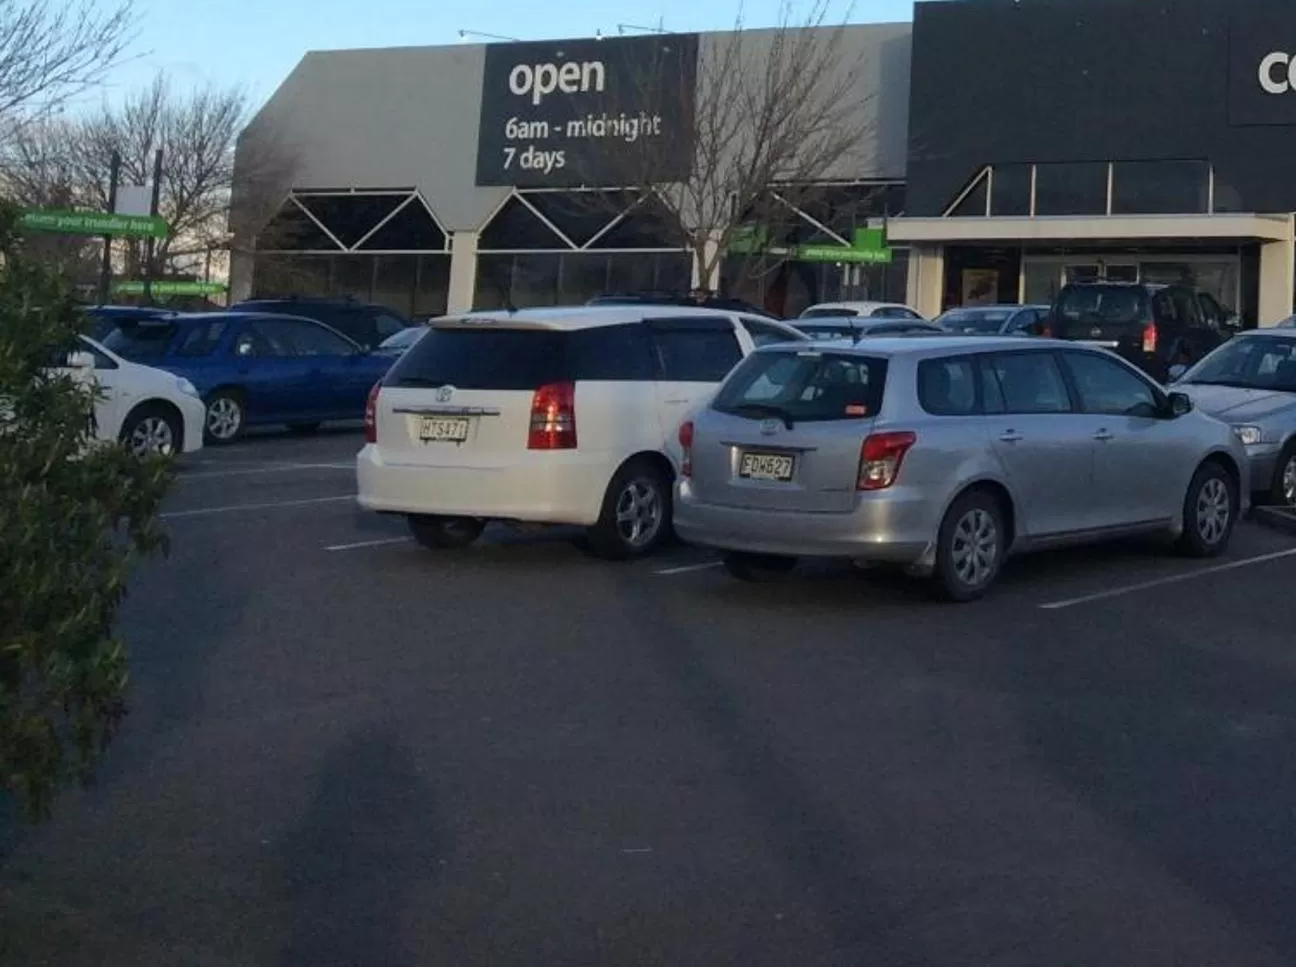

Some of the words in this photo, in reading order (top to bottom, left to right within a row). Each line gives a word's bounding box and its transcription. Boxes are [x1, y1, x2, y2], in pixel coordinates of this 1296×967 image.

[509, 60, 605, 105] open
[505, 117, 549, 139] 6am
[566, 113, 662, 142] midnight
[503, 147, 516, 169] 7
[519, 145, 566, 174] days
